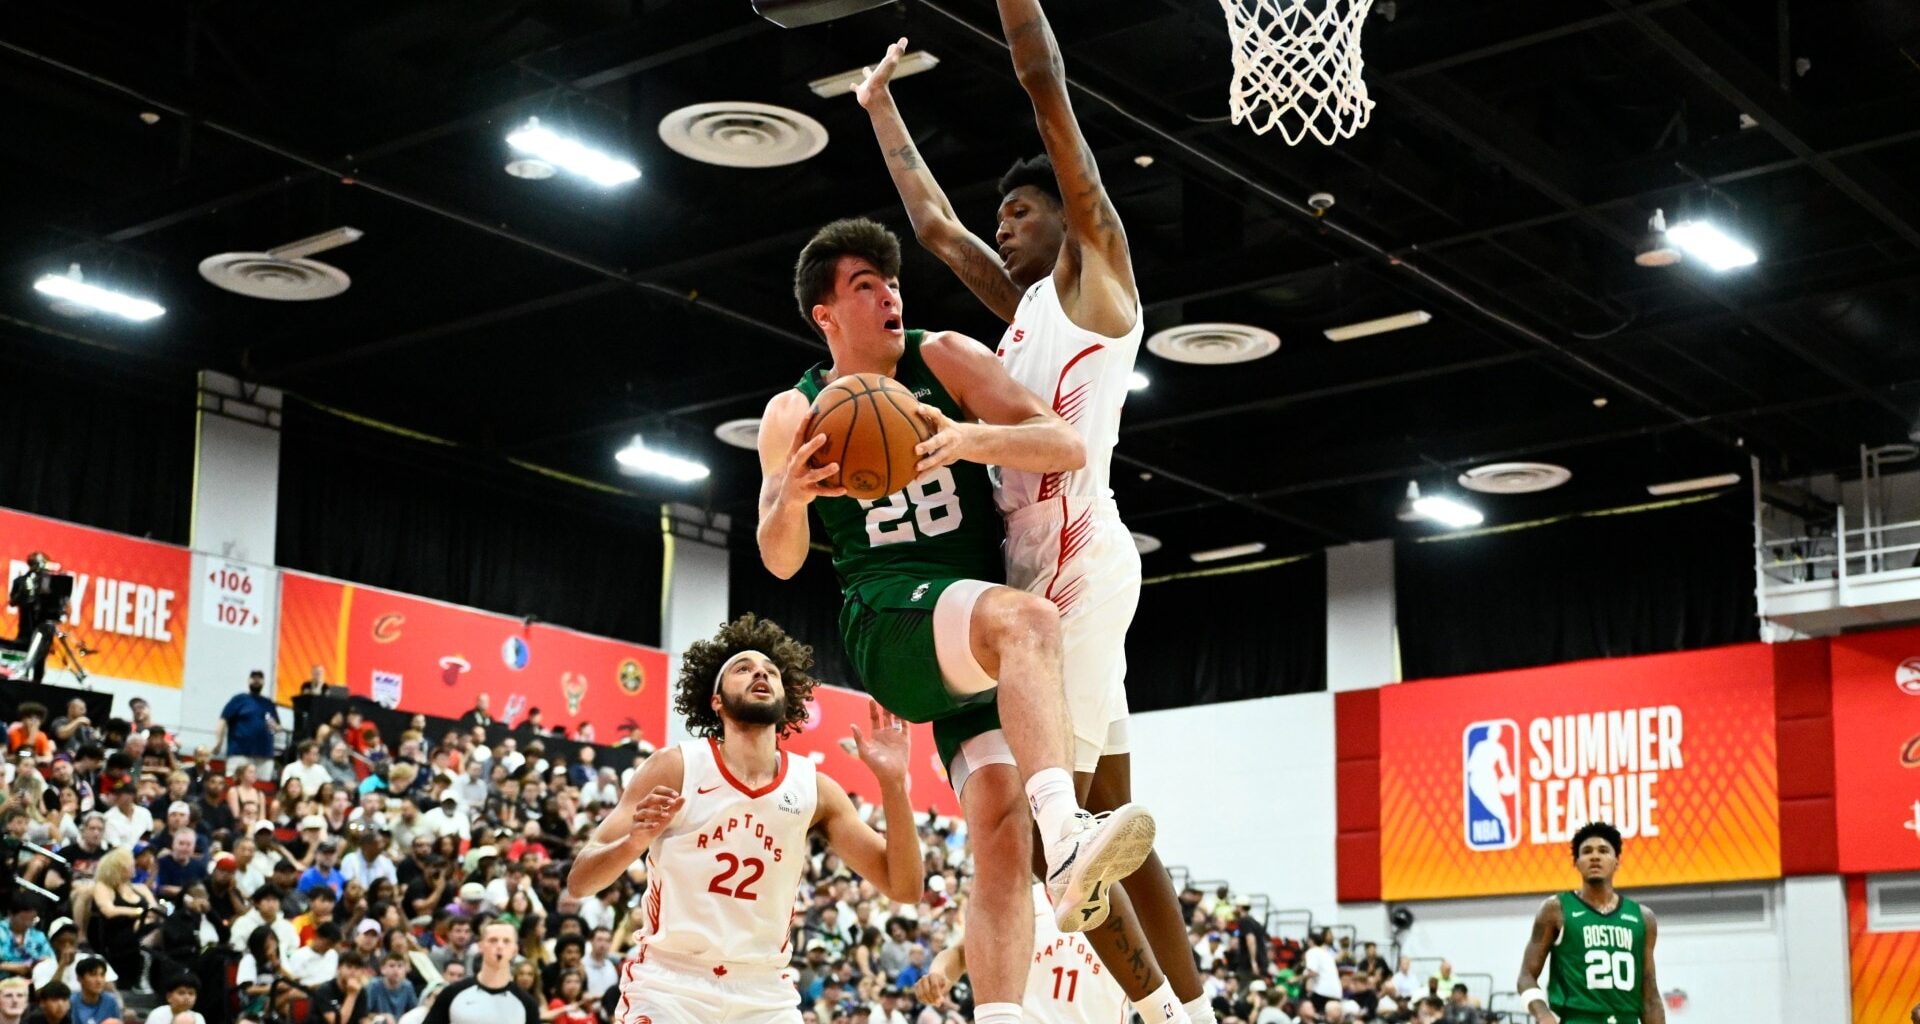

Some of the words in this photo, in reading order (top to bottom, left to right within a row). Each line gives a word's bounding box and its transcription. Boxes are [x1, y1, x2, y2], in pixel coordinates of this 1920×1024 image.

[857, 465, 963, 547] 28
[220, 569, 252, 595] 106
[93, 576, 175, 643] HERE
[217, 603, 250, 626] 107
[1528, 705, 1684, 781] SUMMER
[1529, 772, 1660, 845] LEAGUE
[697, 813, 782, 863] RAPTORS
[1473, 819, 1500, 841] NBA
[708, 852, 765, 901] 22
[1034, 936, 1101, 975] RAPTORS
[1583, 924, 1633, 951] BOSTON
[1052, 966, 1079, 1002] 11
[1584, 950, 1635, 991] 20
